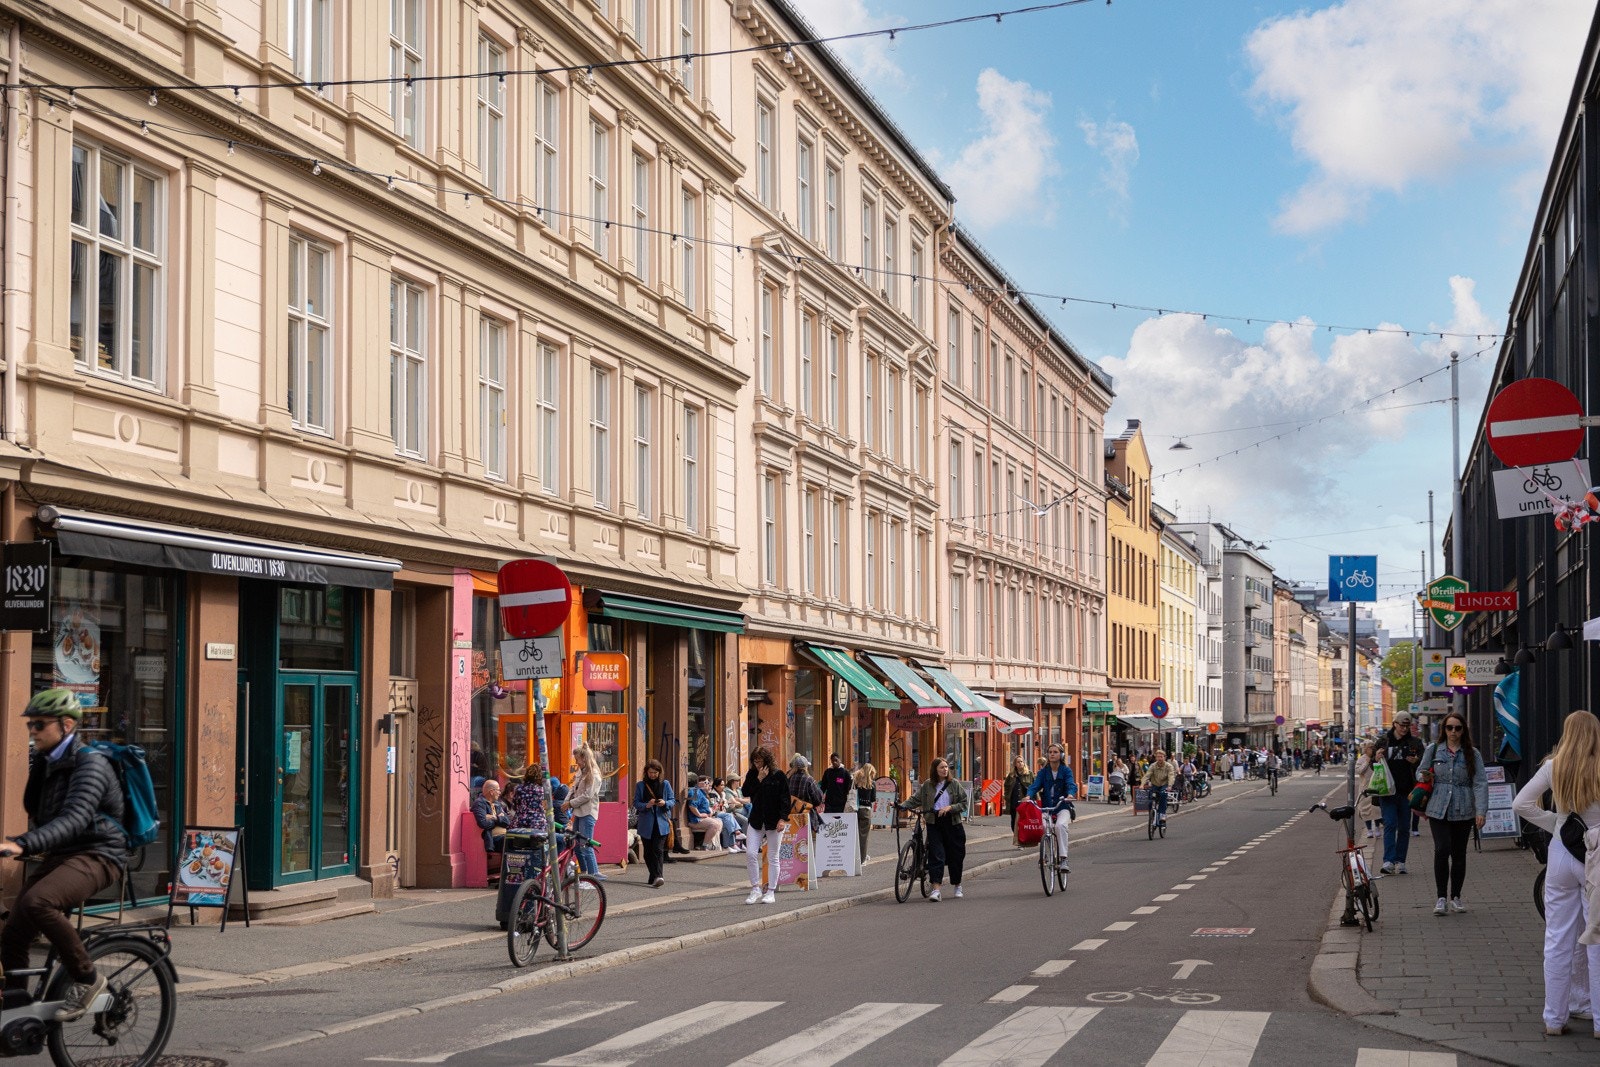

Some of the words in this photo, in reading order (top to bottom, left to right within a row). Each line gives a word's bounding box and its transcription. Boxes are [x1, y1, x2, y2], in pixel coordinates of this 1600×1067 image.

[212, 553, 263, 574] OLIVENLUNDEN
[4, 600, 45, 608] OLIVENLUNDEN
[1431, 600, 1451, 610] IRISH
[1459, 596, 1511, 607] LINDEX
[459, 660, 466, 674] 3
[516, 664, 549, 676] unntatt
[589, 664, 620, 672] VAFLER
[589, 672, 620, 680] ISKREM
[946, 720, 979, 729] sunkost
